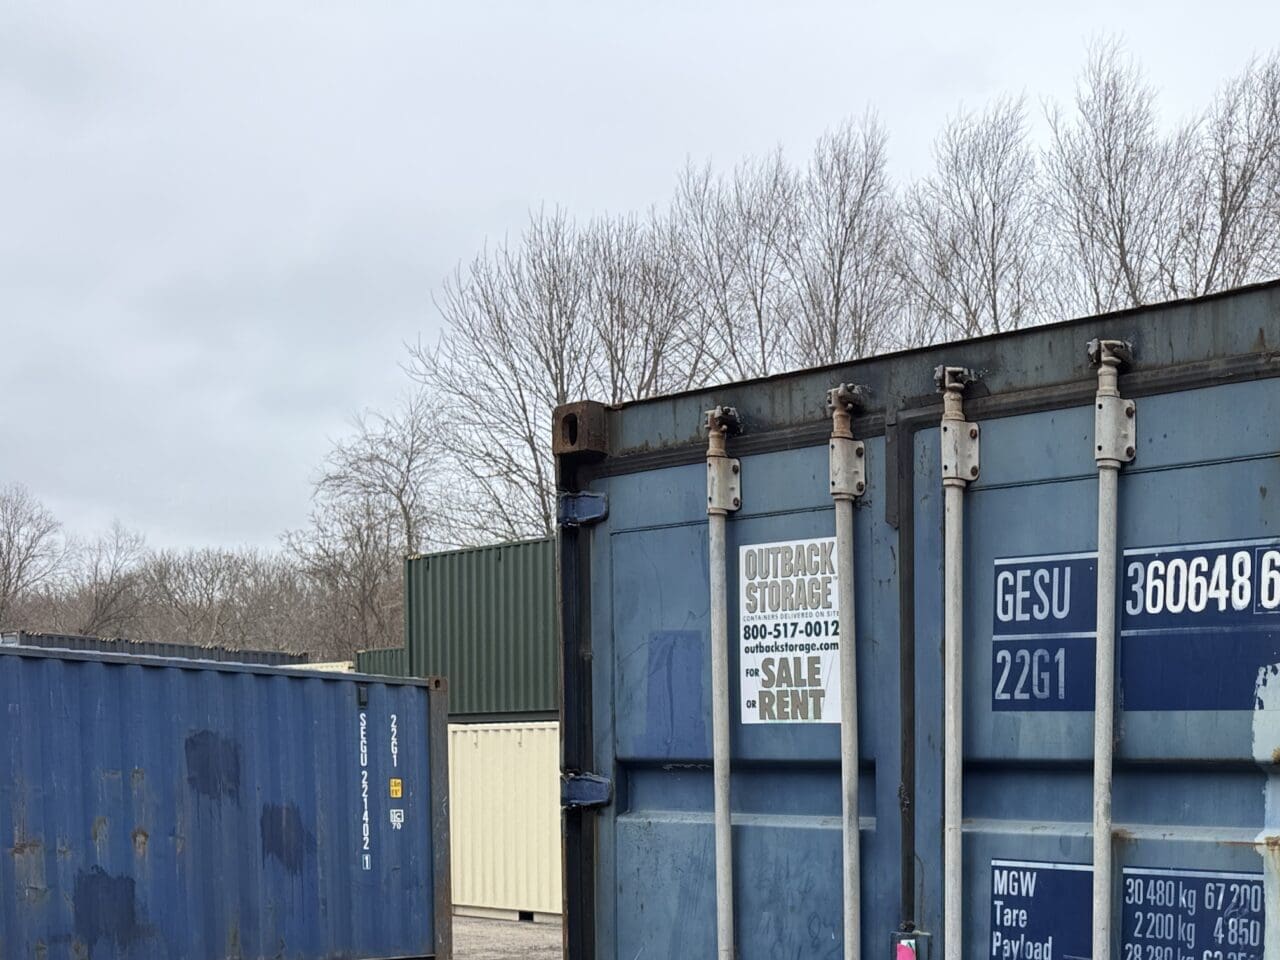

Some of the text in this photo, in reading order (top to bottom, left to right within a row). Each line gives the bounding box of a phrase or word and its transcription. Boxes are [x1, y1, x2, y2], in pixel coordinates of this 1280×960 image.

[745, 541, 836, 581] OUTBACK
[745, 576, 833, 614] STORAGE
[780, 611, 813, 620] DELIVERED
[815, 610, 825, 618] ON
[996, 566, 1072, 623] GESU
[743, 620, 840, 641] 800-517-0012
[744, 641, 840, 654] outbackstorage.com
[745, 656, 822, 689] FOR SALE
[994, 647, 1066, 700] 22G1
[746, 689, 826, 720] OR RENT
[359, 712, 368, 767] SEGU
[390, 714, 398, 767] 22G1
[361, 770, 370, 850] 221402
[994, 869, 1037, 898] MGW
[1179, 880, 1197, 917] kg
[993, 900, 1028, 928] Tare
[1177, 913, 1196, 950] kg
